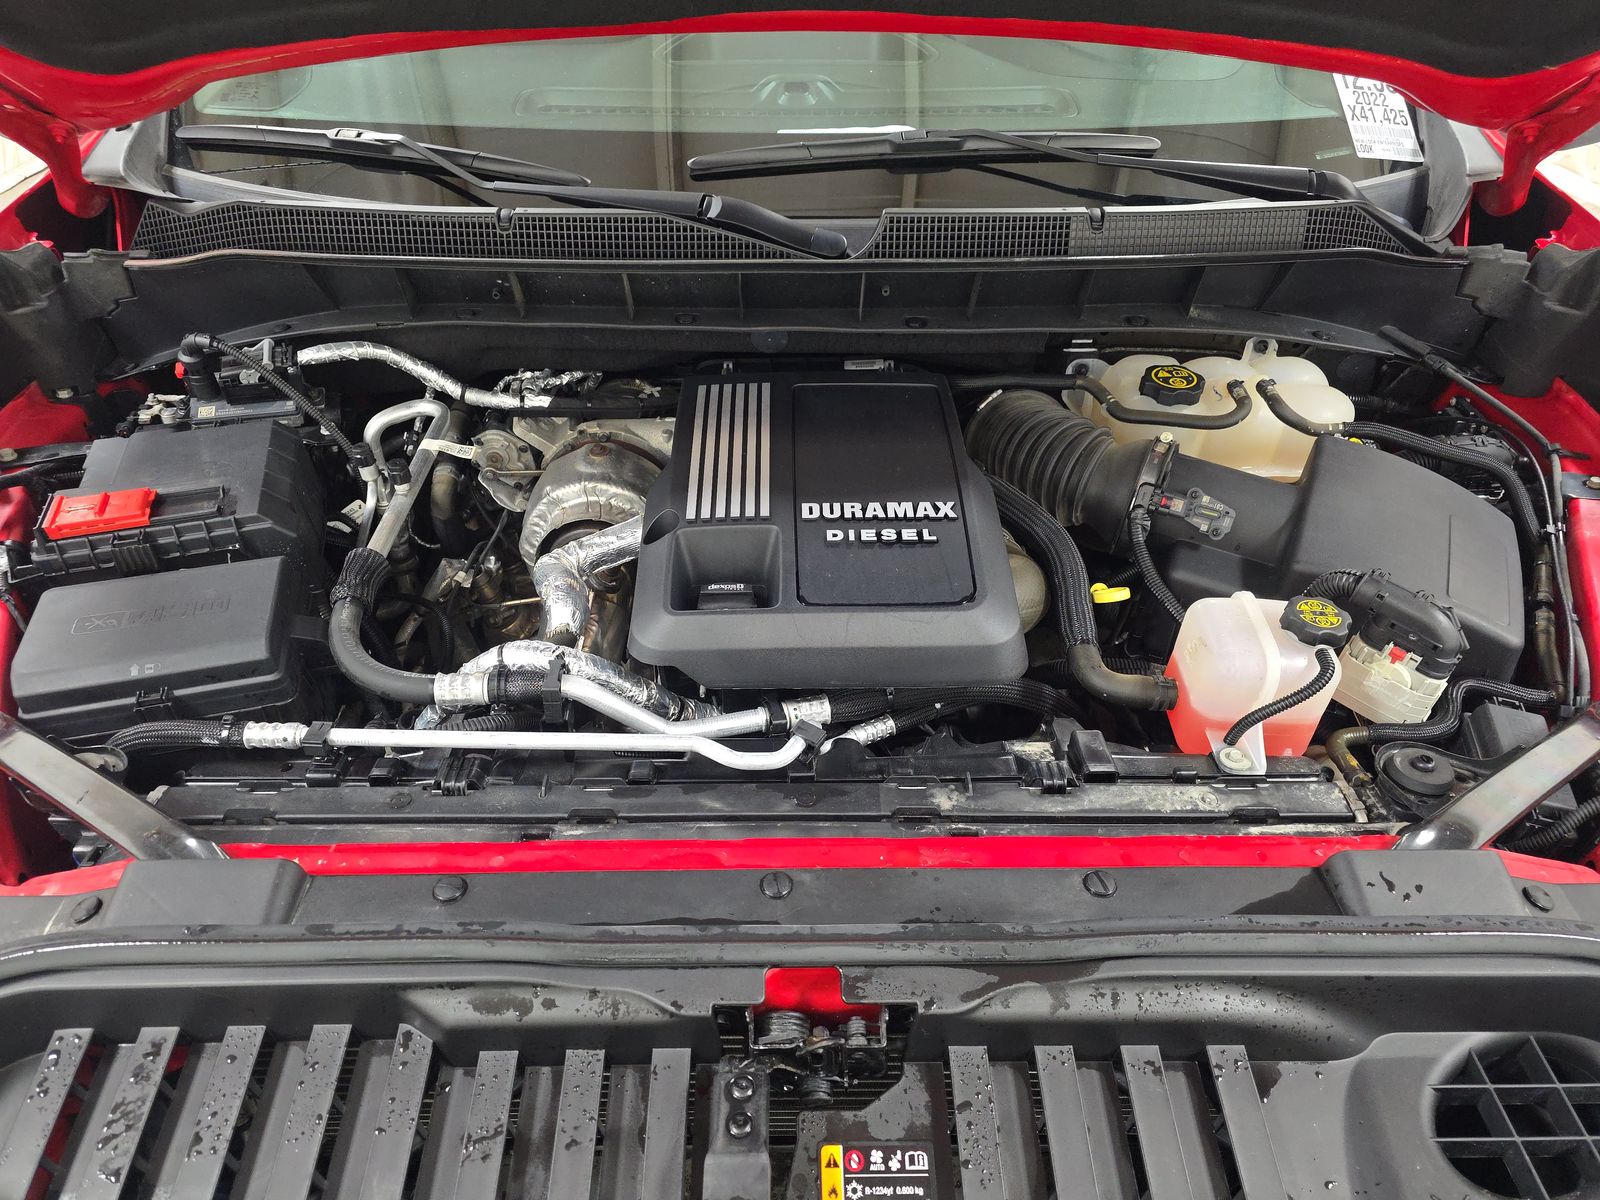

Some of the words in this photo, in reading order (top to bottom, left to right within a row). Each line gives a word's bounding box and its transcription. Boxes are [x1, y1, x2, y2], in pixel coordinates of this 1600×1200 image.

[1352, 90, 1389, 107] 2022
[1347, 104, 1409, 126] X41,425
[1356, 143, 1374, 153] LOOK
[801, 501, 958, 520] DURAMAX
[826, 528, 938, 542] DIESEL
[869, 1163, 885, 1171] AUTO
[915, 1186, 924, 1196] kg
